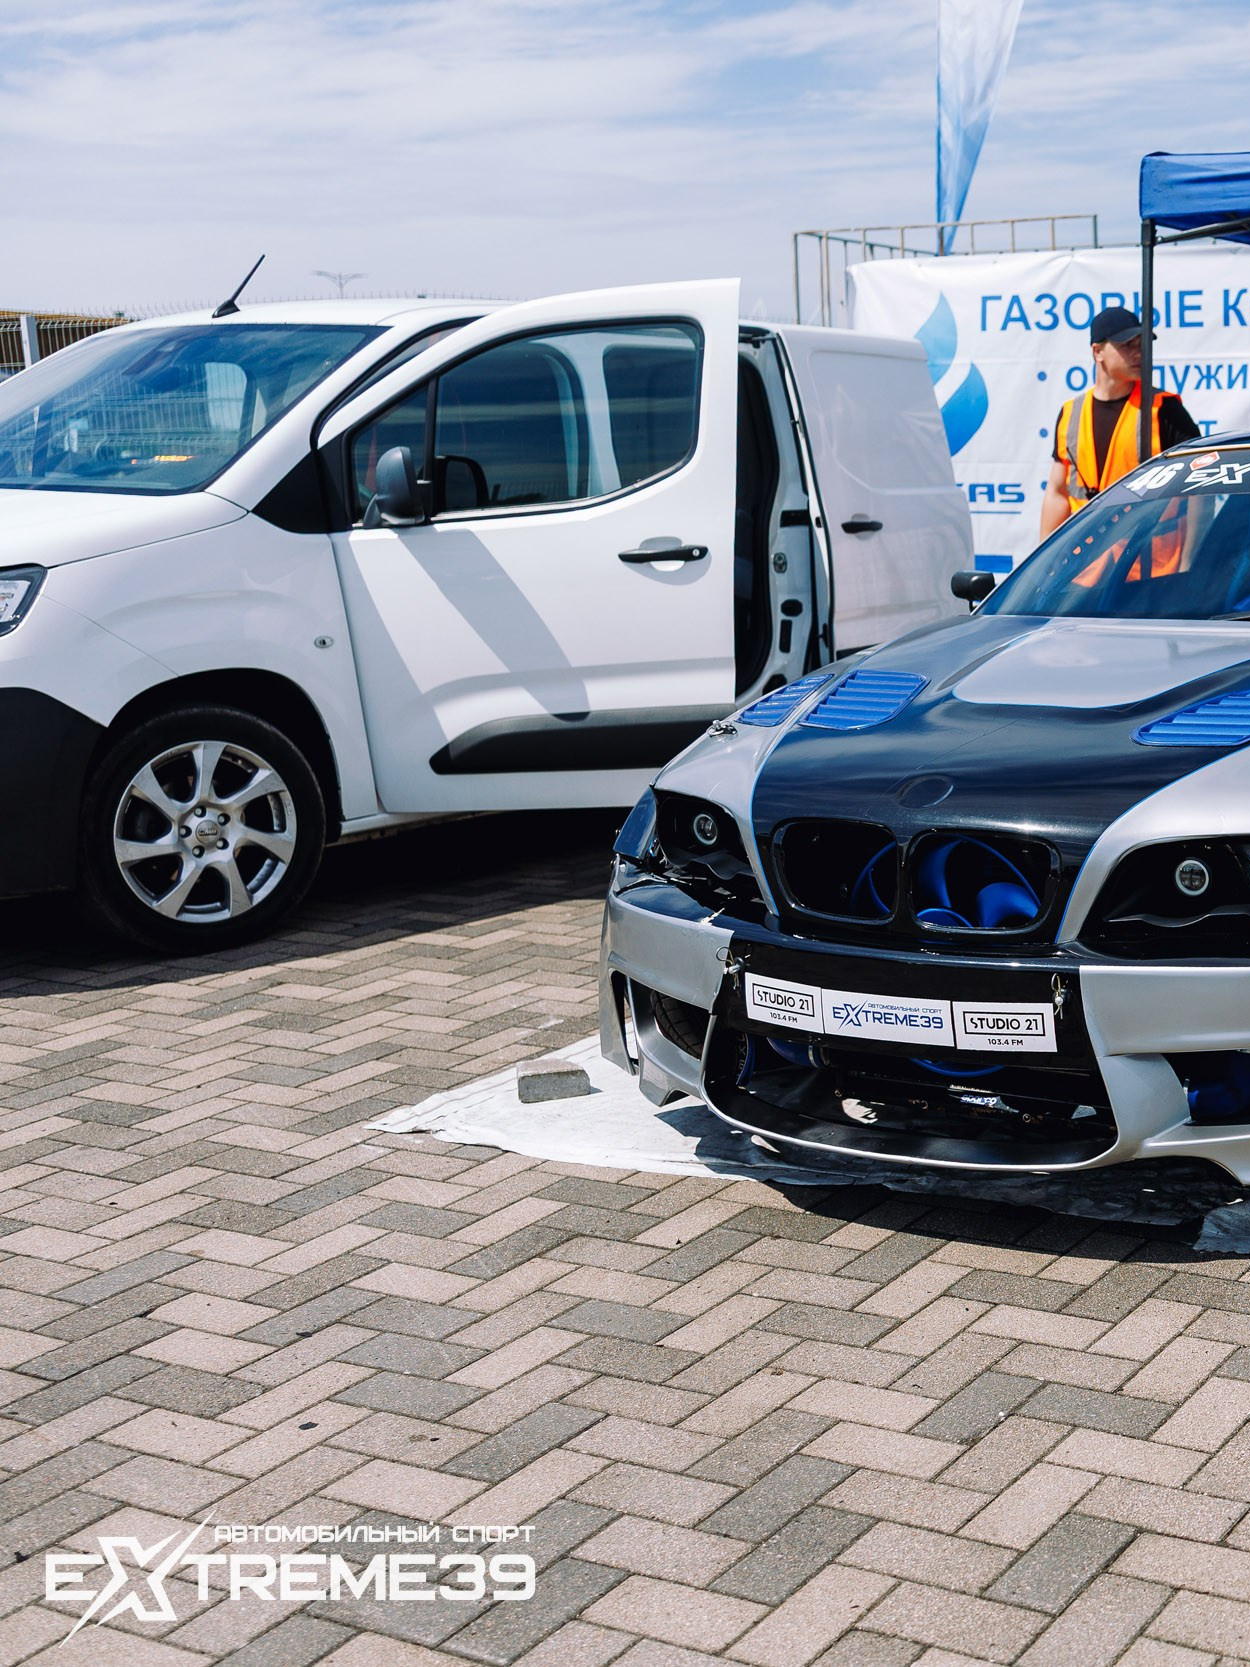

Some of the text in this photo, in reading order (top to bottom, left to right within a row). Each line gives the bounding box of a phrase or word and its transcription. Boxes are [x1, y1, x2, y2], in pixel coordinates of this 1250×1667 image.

[1126, 462, 1184, 491] 46
[757, 990, 810, 1011] STUDIO 21
[769, 1011, 798, 1023] 103.4 FM
[832, 999, 944, 1030] EXTREME39
[922, 1007, 942, 1015] СПОРТ
[970, 1017, 1039, 1031] STUDIO 21
[987, 1038, 1010, 1046] 103.4
